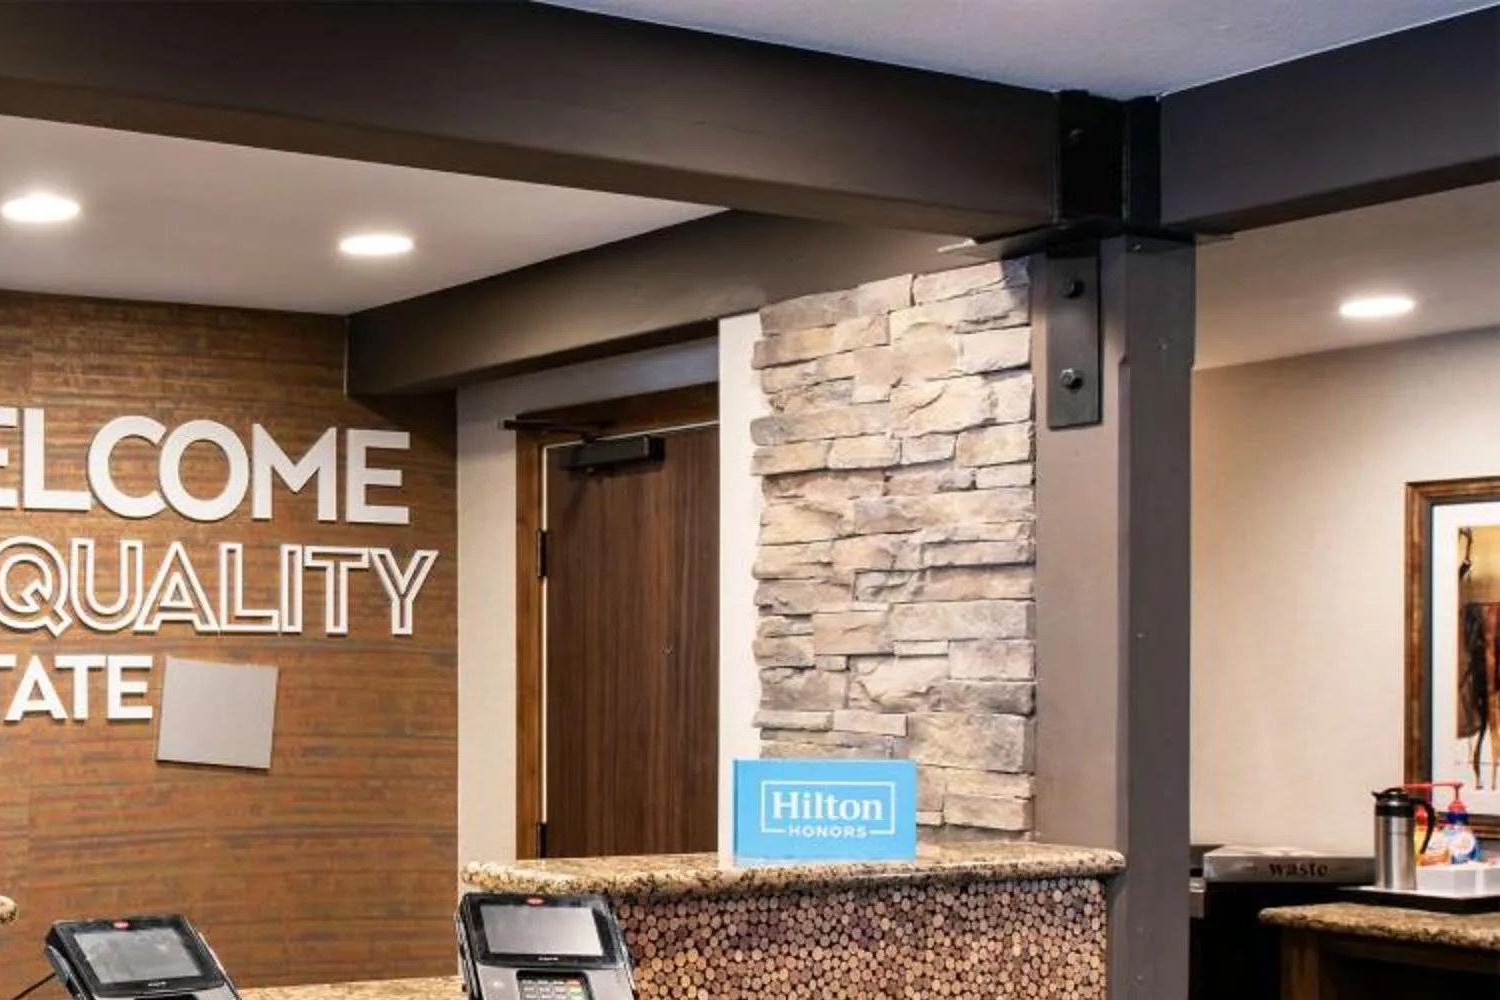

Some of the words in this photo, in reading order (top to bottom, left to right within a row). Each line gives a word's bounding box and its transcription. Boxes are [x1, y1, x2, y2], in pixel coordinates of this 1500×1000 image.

[771, 790, 884, 821] Hilton
[788, 824, 869, 838] HONORS
[1268, 862, 1329, 877] waste
